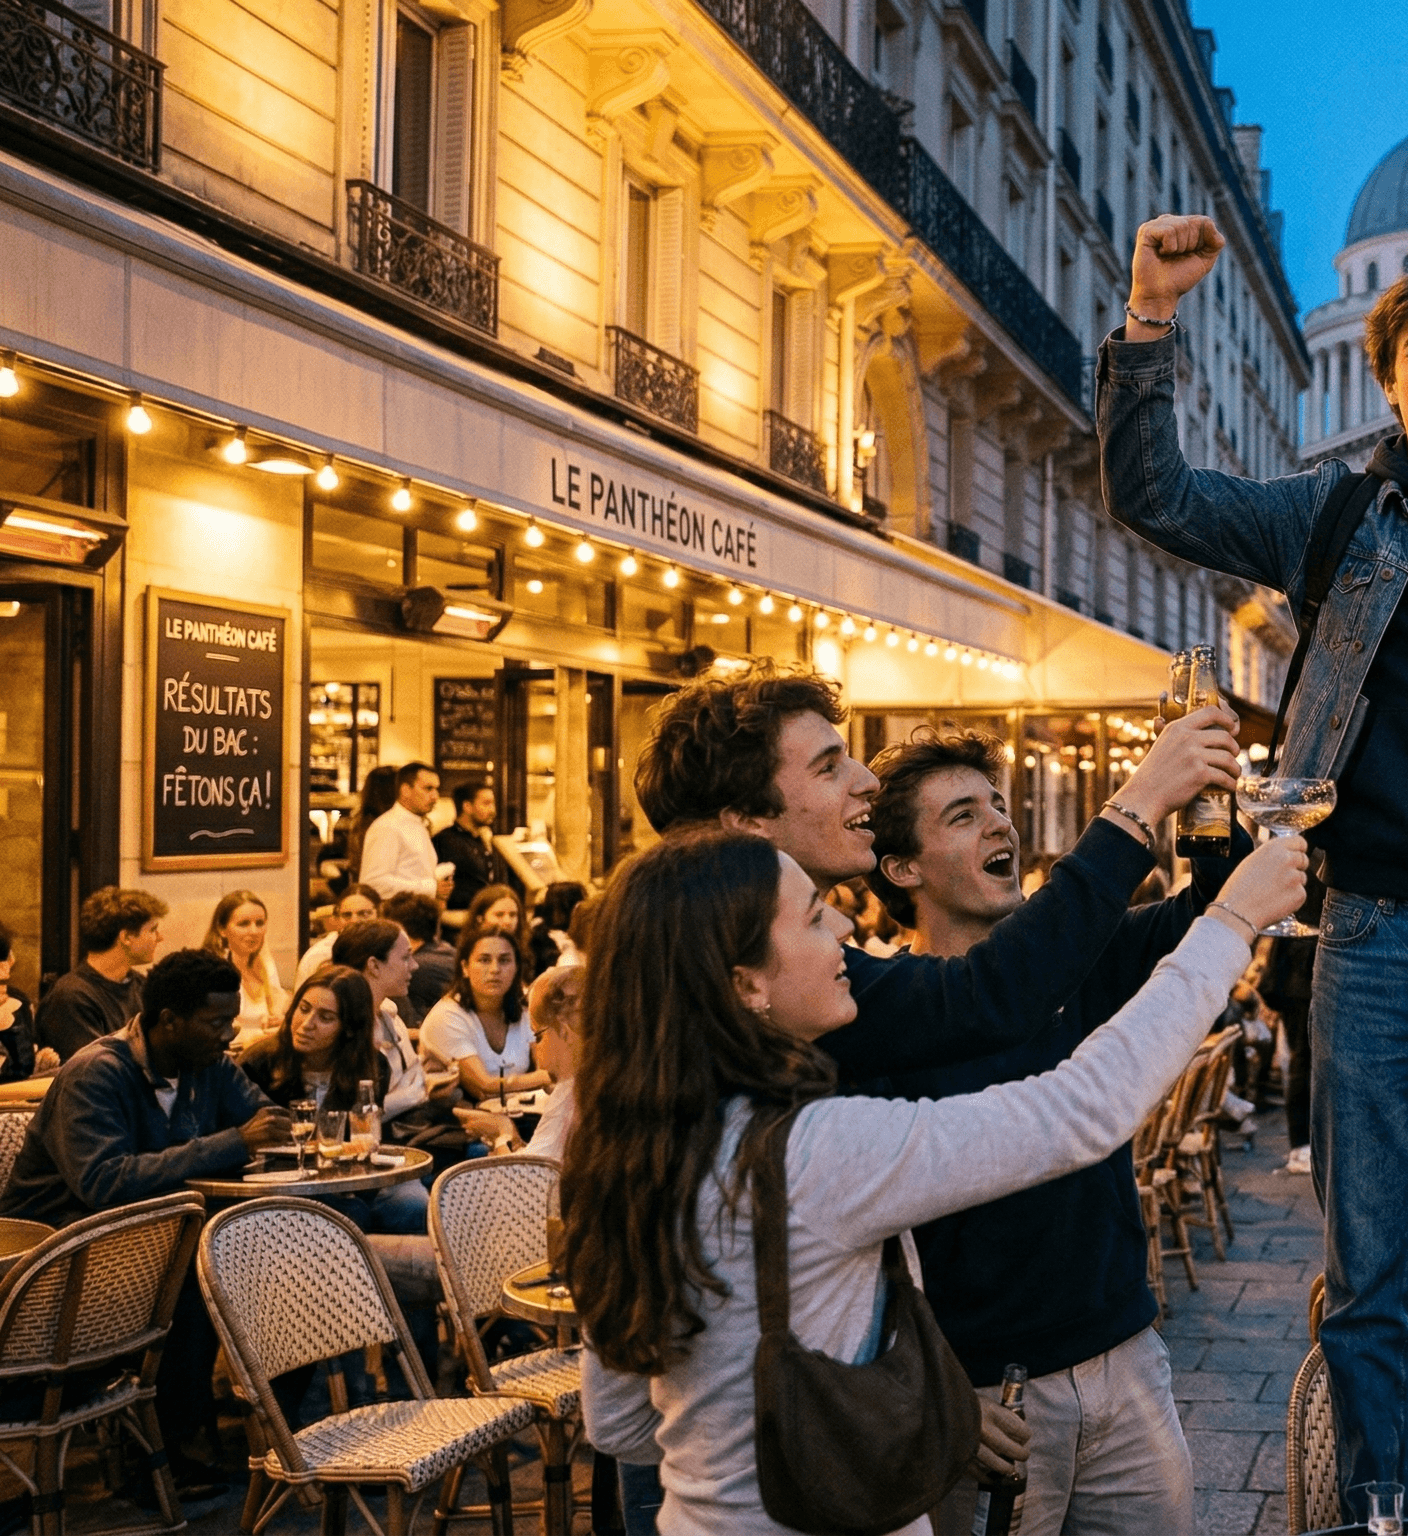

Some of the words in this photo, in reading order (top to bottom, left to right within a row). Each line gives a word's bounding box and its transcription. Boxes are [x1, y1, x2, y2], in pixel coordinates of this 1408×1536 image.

[552, 457, 581, 511] LE
[590, 472, 705, 551] PANTHÉON
[711, 519, 757, 568] CAFÉ
[165, 617, 182, 639] LE
[184, 620, 246, 649] PANTHÉON
[247, 627, 277, 652] CAFÉ
[163, 671, 272, 720] RÉSULTATS
[183, 725, 208, 754] DU
[213, 726, 248, 756] BAC
[163, 765, 235, 807] FÊTONS
